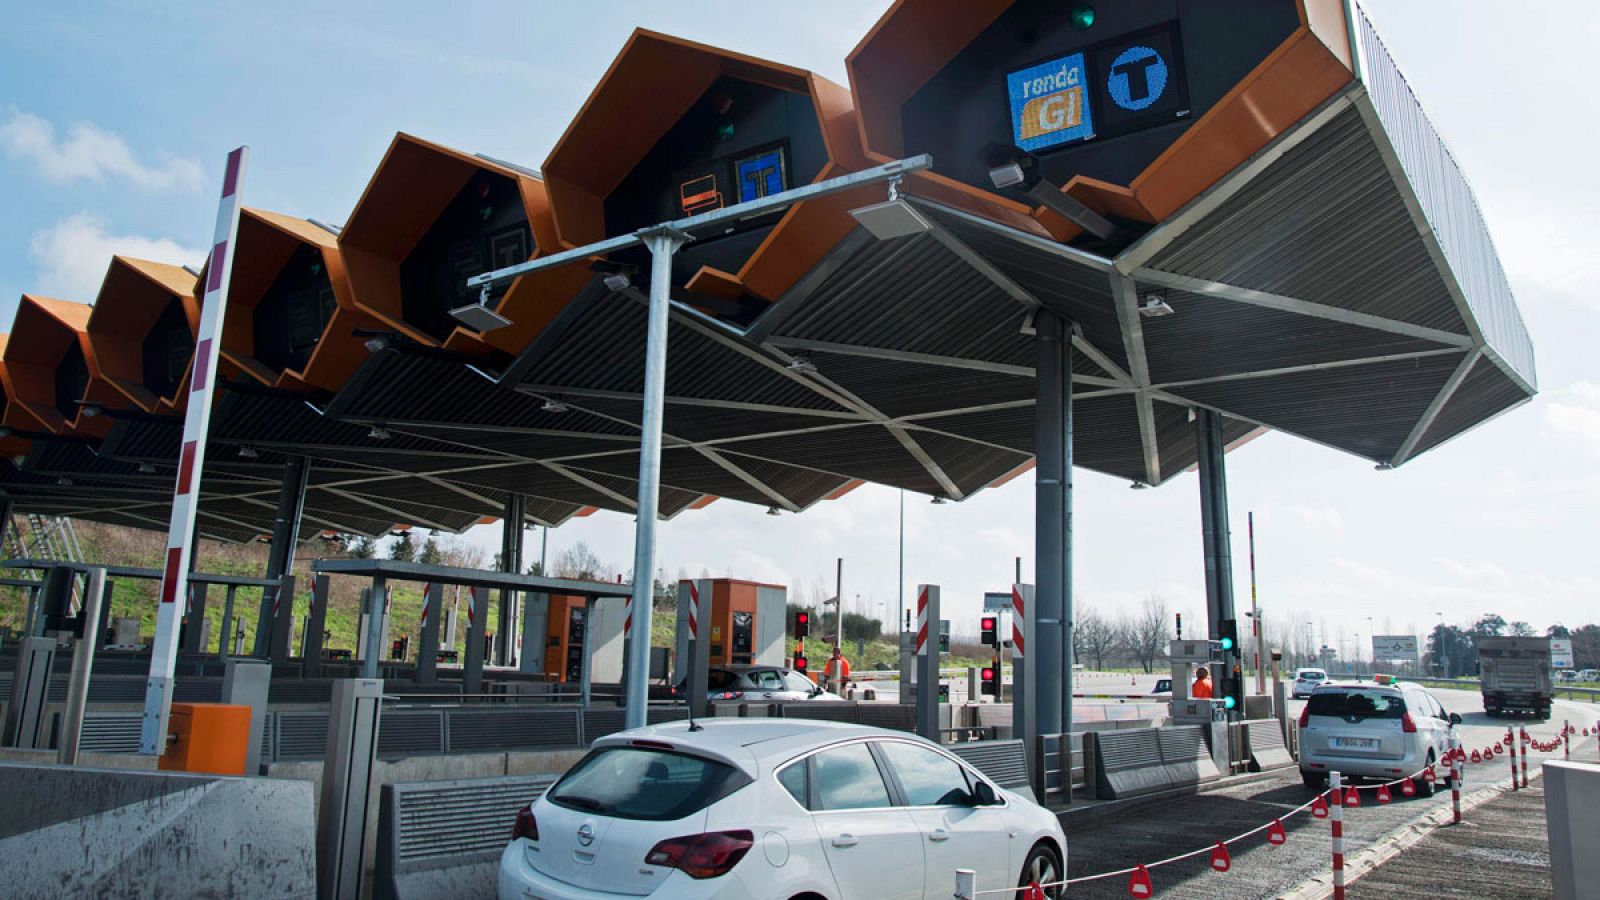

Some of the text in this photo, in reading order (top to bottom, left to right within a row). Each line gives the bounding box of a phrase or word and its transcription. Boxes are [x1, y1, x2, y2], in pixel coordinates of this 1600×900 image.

[1023, 63, 1079, 99] ronda
[1113, 55, 1158, 102] T
[745, 166, 776, 199] T
